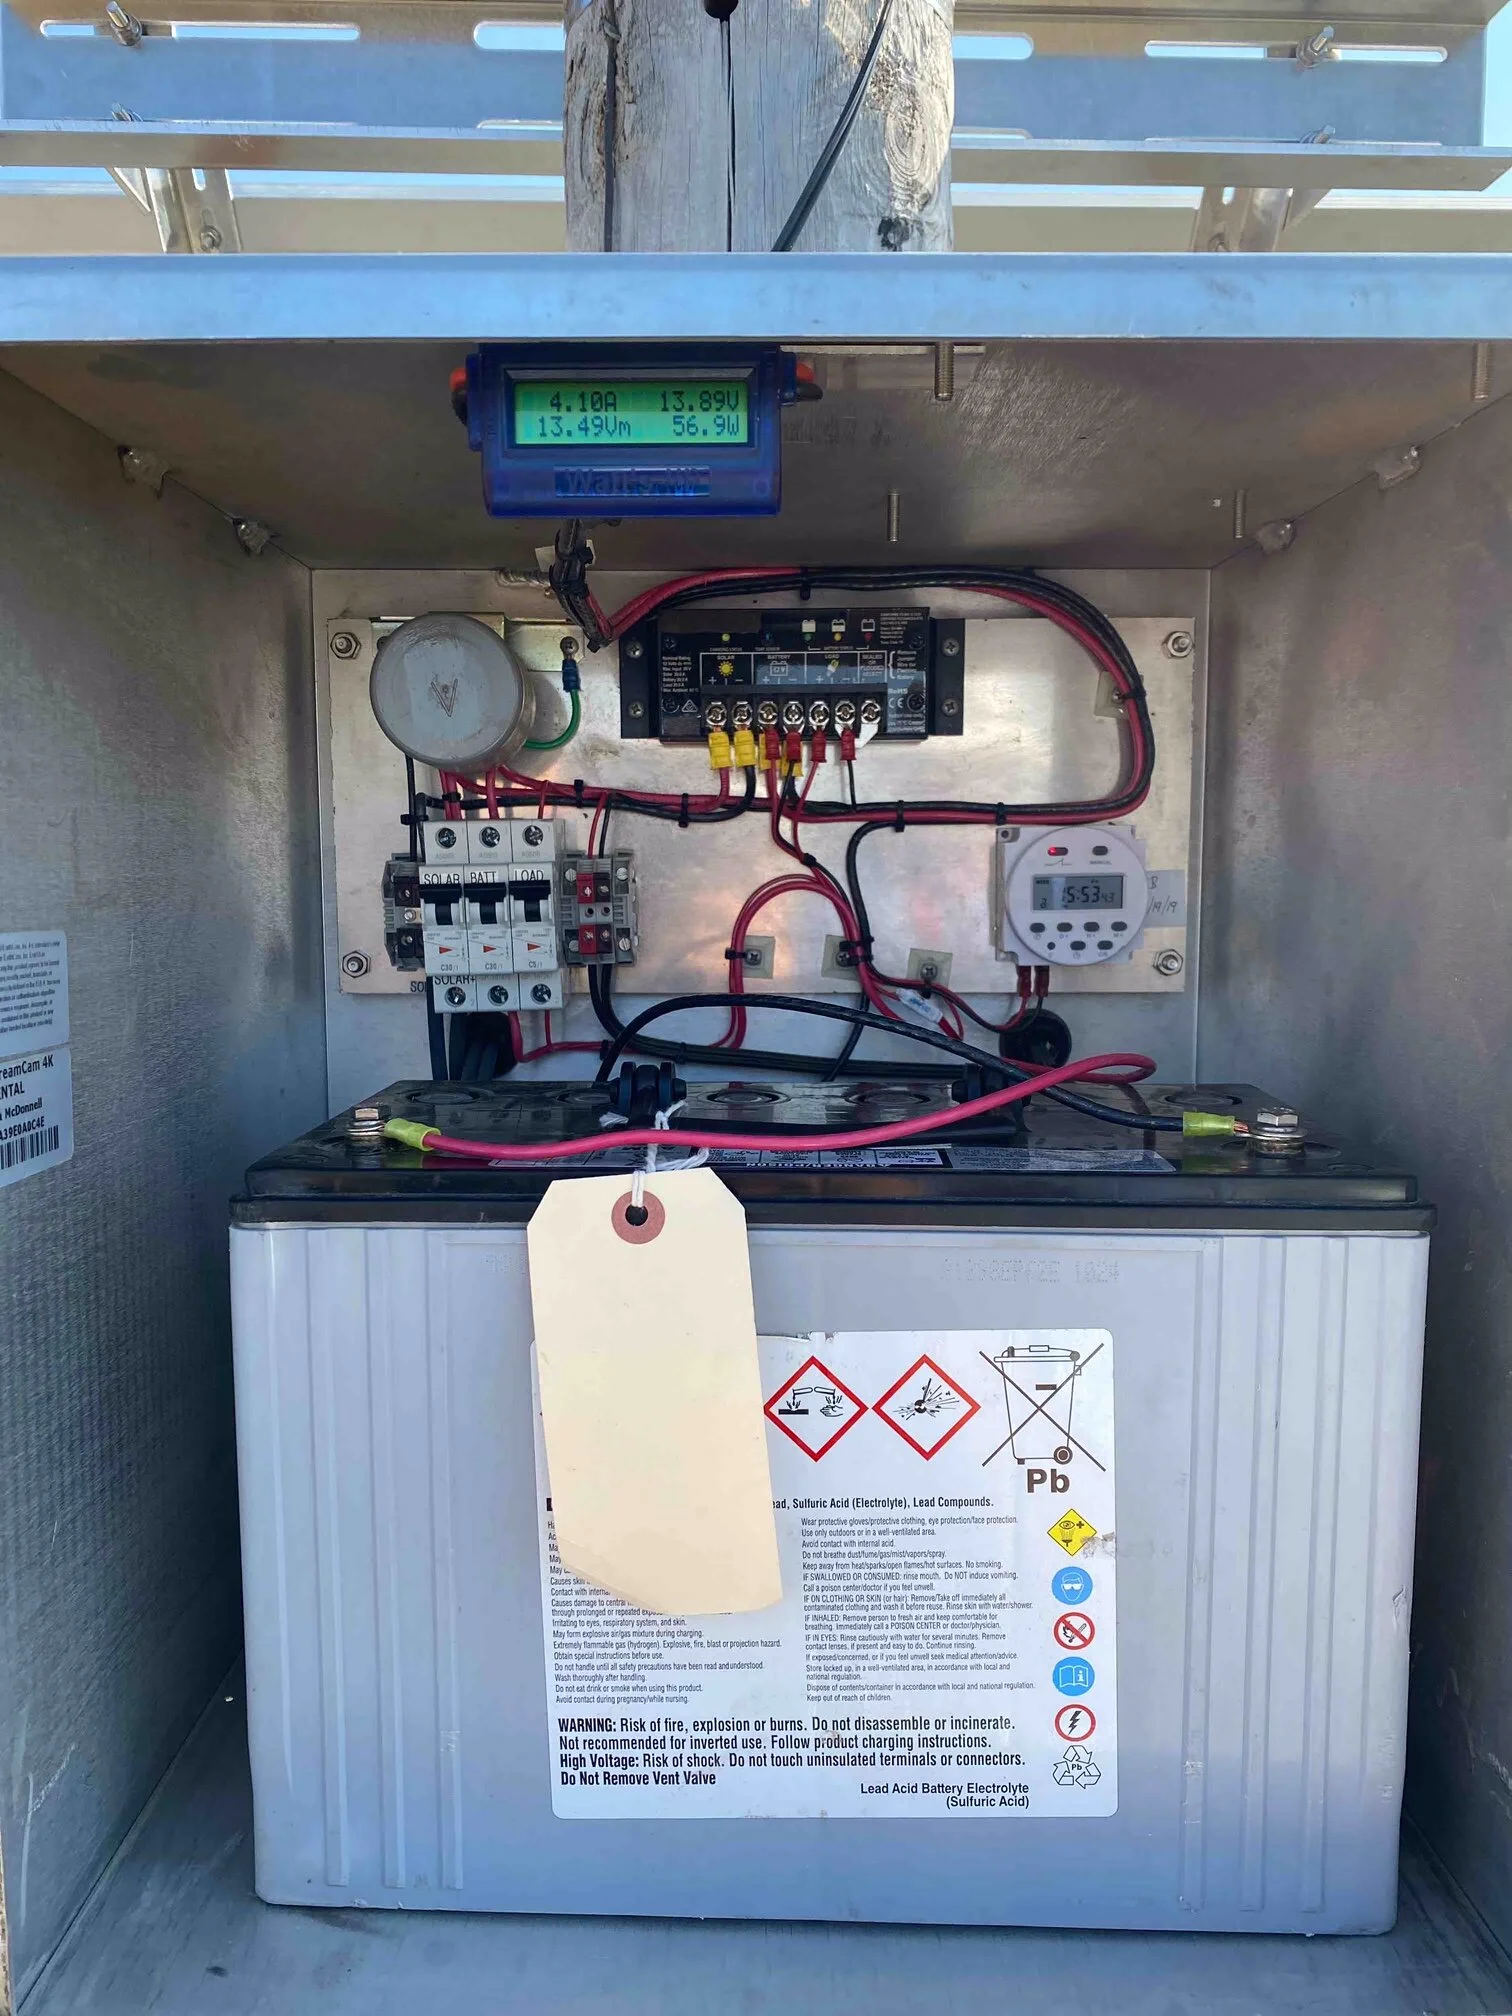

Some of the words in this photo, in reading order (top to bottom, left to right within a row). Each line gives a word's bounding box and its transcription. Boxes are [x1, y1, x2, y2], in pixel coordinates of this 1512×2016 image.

[550, 391, 617, 412] 4.10A
[660, 390, 740, 412] 13.89V
[539, 415, 632, 438] 13.49Vm
[672, 414, 740, 436] 56.9W
[424, 874, 460, 884] SOLAR
[470, 871, 496, 883] BATT
[514, 870, 544, 880] LOAD
[42, 1054, 54, 1068] 4K
[0, 1081, 25, 1100] NTAL
[5, 1096, 43, 1119] McDonnell
[1027, 1468, 1070, 1494] Pb
[772, 1498, 789, 1509] ead,
[792, 1498, 827, 1508] Sulfuric
[830, 1498, 849, 1508] Acid
[852, 1497, 910, 1510] (Electrolyte),
[913, 1496, 935, 1507] Lead
[938, 1496, 993, 1508] Compounds.
[818, 1518, 847, 1526] protective
[848, 1516, 899, 1526] gloves/protective
[900, 1516, 926, 1526] clothing,
[940, 1515, 984, 1525] protection/face
[986, 1516, 1018, 1524] protection.
[858, 1539, 880, 1547] internal
[552, 1630, 565, 1639] May
[582, 1630, 609, 1638] explosive
[610, 1629, 630, 1639] air/gas
[656, 1629, 675, 1638] during
[676, 1629, 703, 1638] charging.
[553, 1651, 573, 1660] Obtain
[574, 1651, 594, 1660] special
[631, 1651, 650, 1659] before
[831, 1671, 862, 1681] regulation.
[648, 1684, 664, 1693] using
[678, 1683, 703, 1693] product.
[558, 1718, 616, 1732] WARNING:
[620, 1717, 645, 1731] Risk
[650, 1717, 660, 1731] of
[664, 1717, 688, 1733] fire,
[693, 1717, 749, 1734] explosion
[754, 1720, 766, 1731] or
[770, 1717, 806, 1731] burns.
[812, 1716, 827, 1730] Do
[832, 1717, 850, 1733] not
[854, 1716, 930, 1730] disassemble
[934, 1719, 946, 1730] or
[950, 1715, 1015, 1729] incinerate.
[559, 1735, 578, 1750] Not
[582, 1735, 666, 1749] recommended
[670, 1735, 686, 1749] for
[690, 1733, 737, 1749] inverted
[741, 1738, 766, 1749] use.
[771, 1734, 810, 1748] Follow
[814, 1734, 858, 1751] product
[862, 1734, 913, 1751] charging
[918, 1733, 991, 1748] instructions.
[560, 1753, 586, 1770] High
[589, 1753, 638, 1770] Voltage:
[643, 1753, 668, 1767] Risk
[672, 1753, 682, 1767] of
[687, 1752, 724, 1767] shock.
[729, 1752, 744, 1766] Do
[749, 1753, 766, 1766] not
[771, 1752, 802, 1766] touch
[807, 1750, 875, 1766] uninsulated
[880, 1750, 936, 1766] terminals
[940, 1754, 952, 1765] or
[956, 1751, 1025, 1765] connectors.
[561, 1769, 576, 1785] Do
[579, 1771, 599, 1785] Not
[603, 1769, 649, 1785] Remove
[653, 1771, 679, 1785] Vent
[683, 1770, 716, 1784] Valve
[860, 1783, 888, 1793] Lead
[892, 1782, 918, 1793] Acid
[922, 1782, 963, 1794] Battery
[966, 1782, 1029, 1794] Electrolyte
[946, 1795, 995, 1809] (Sulfuric
[999, 1794, 1029, 1809] Acid)
